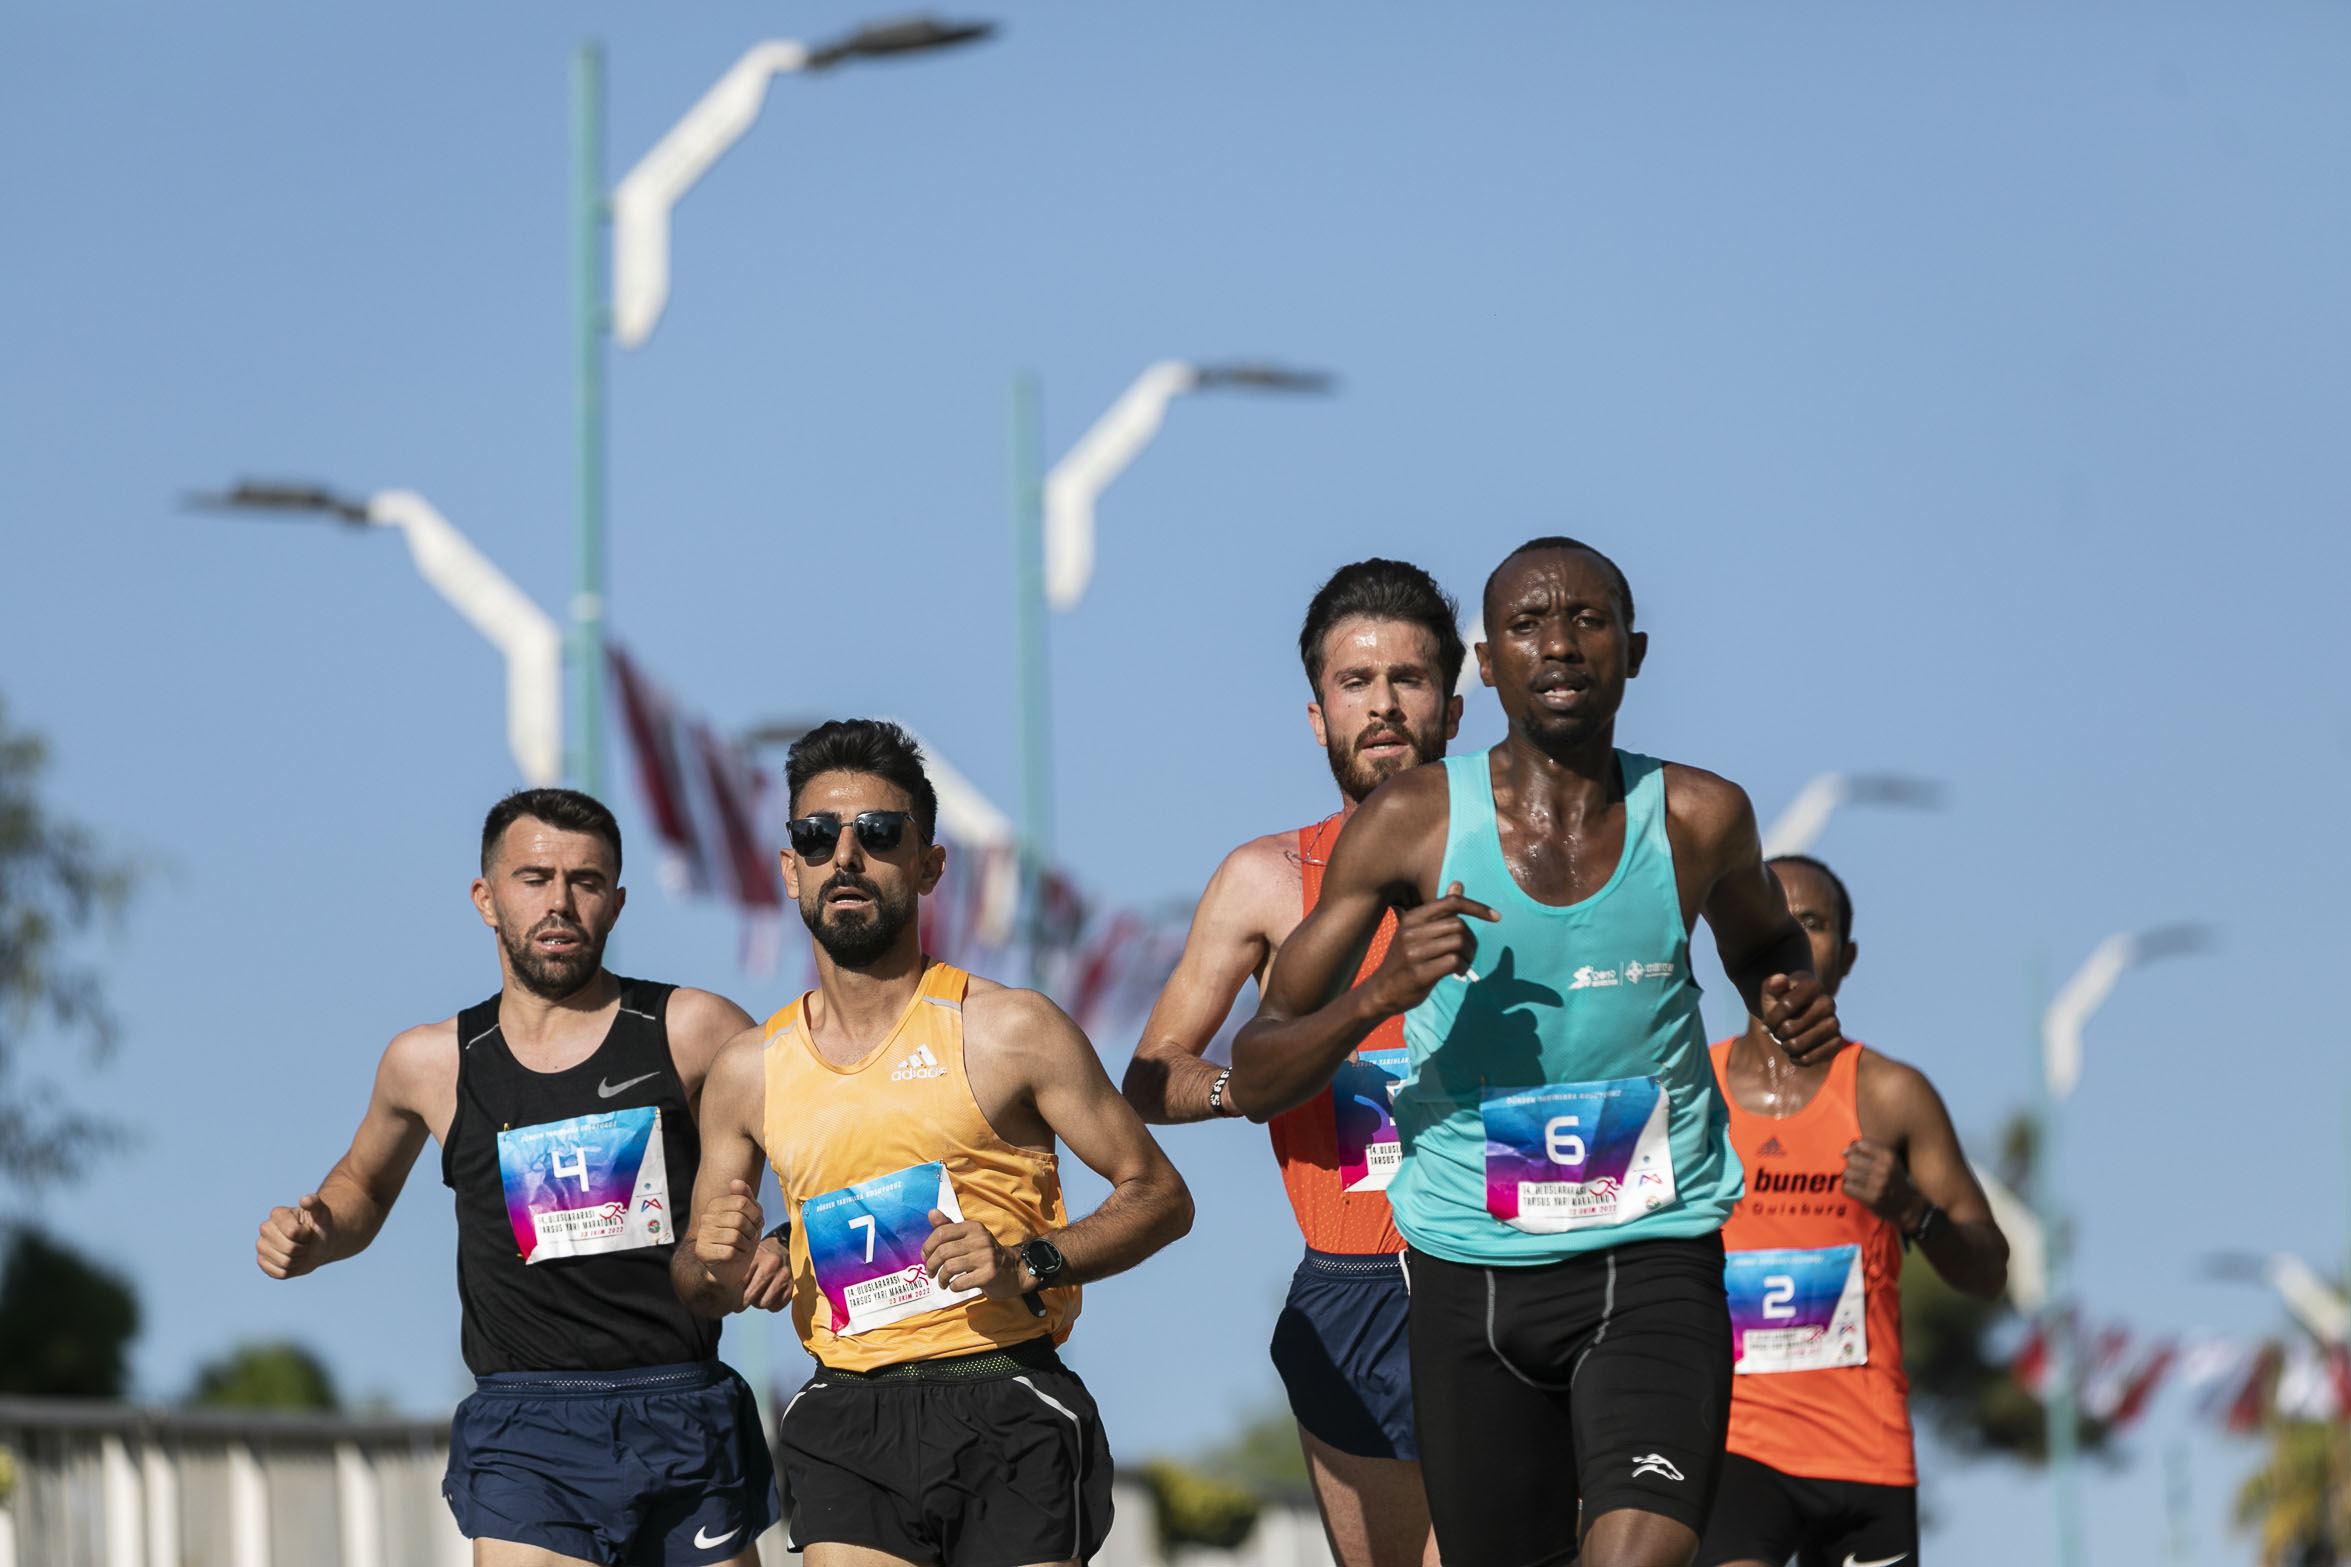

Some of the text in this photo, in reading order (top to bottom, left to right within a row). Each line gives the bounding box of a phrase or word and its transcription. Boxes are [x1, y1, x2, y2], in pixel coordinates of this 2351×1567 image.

[891, 1068, 947, 1082] adidas
[1544, 1115, 1586, 1166] 6
[551, 1147, 590, 1192] 4
[1370, 1156, 1395, 1165] TARSUS
[848, 1214, 876, 1264] 7
[849, 1280, 923, 1308] TARSUS YARI MARATONU
[857, 1275, 900, 1296] ULUSLARARASI
[915, 1288, 931, 1299] 2022
[1762, 1275, 1797, 1319] 2
